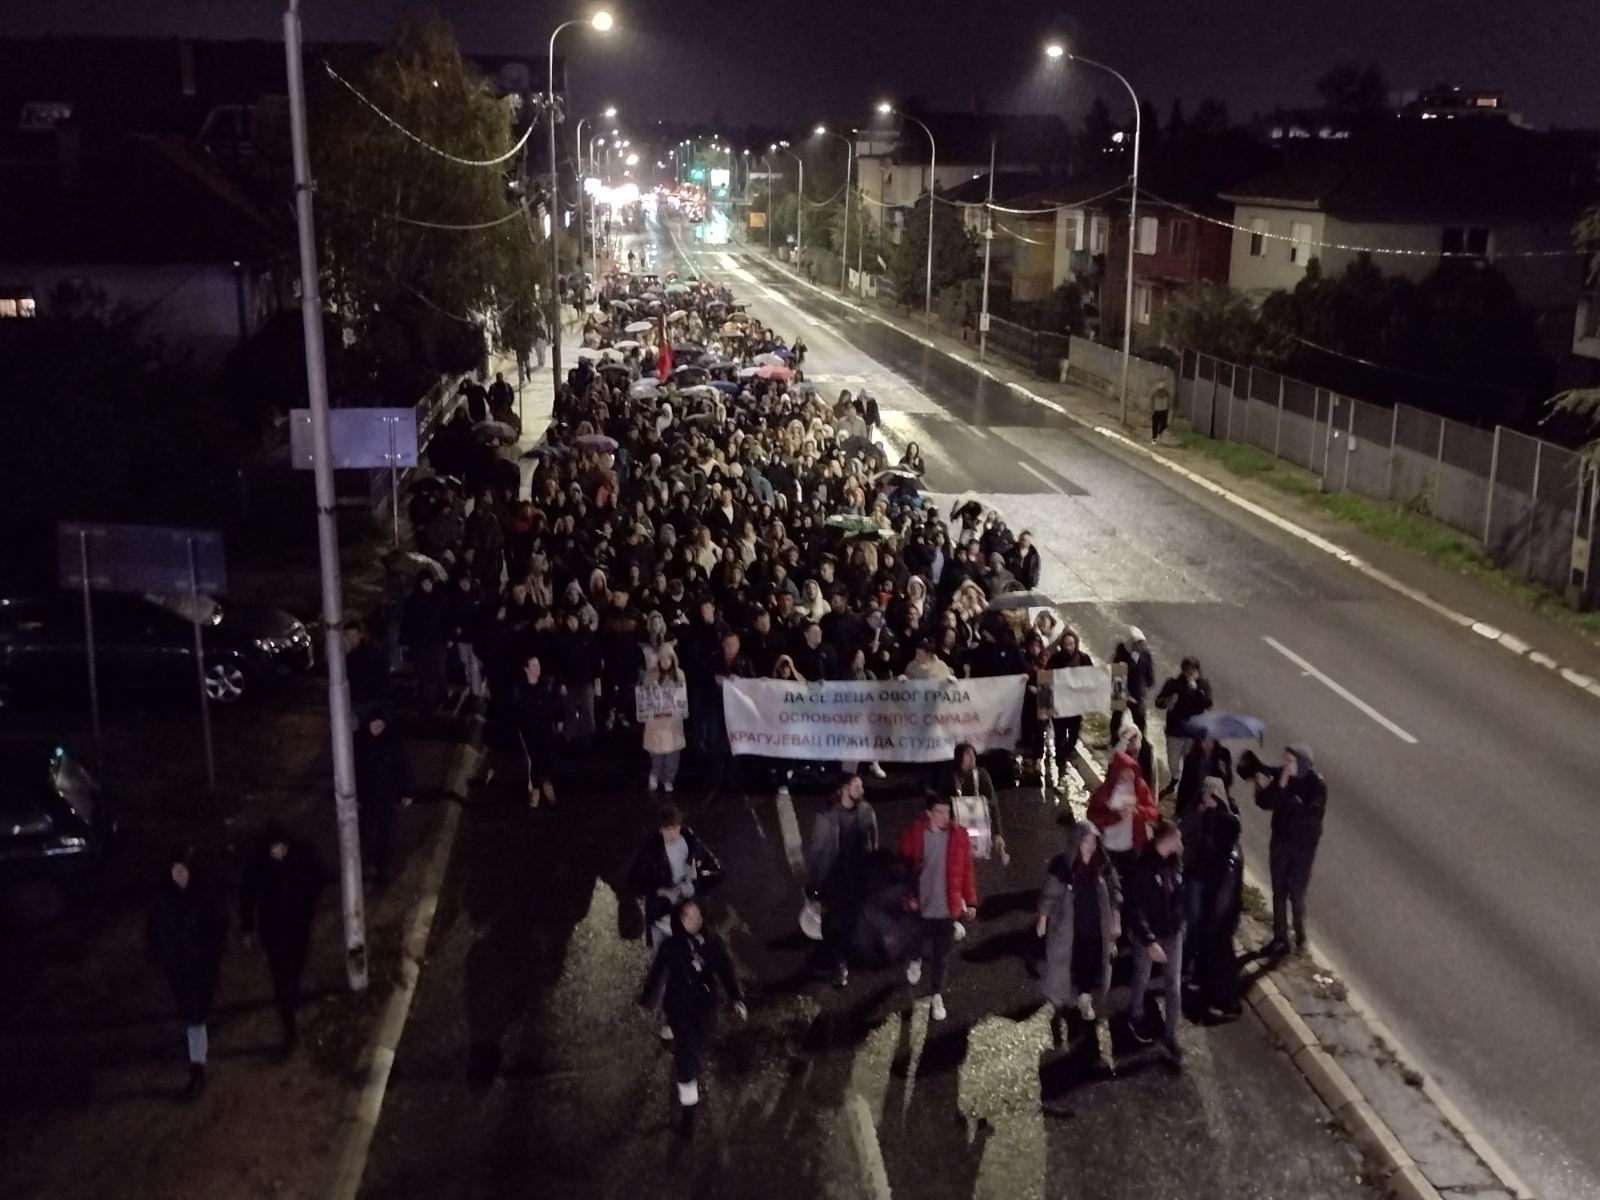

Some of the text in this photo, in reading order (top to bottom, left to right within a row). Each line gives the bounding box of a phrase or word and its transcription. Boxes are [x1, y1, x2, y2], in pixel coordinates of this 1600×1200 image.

[784, 691, 804, 703] ДА
[834, 692, 874, 704] ДЕЦА
[878, 689, 919, 703] ОВОГ
[924, 689, 971, 704] ГРАДА
[779, 711, 863, 725] ОСЛОБОДЕ
[730, 730, 822, 748] КРАГУЈЕВАЦ
[826, 734, 869, 748] ПРЖИ
[874, 735, 895, 749] ДА
